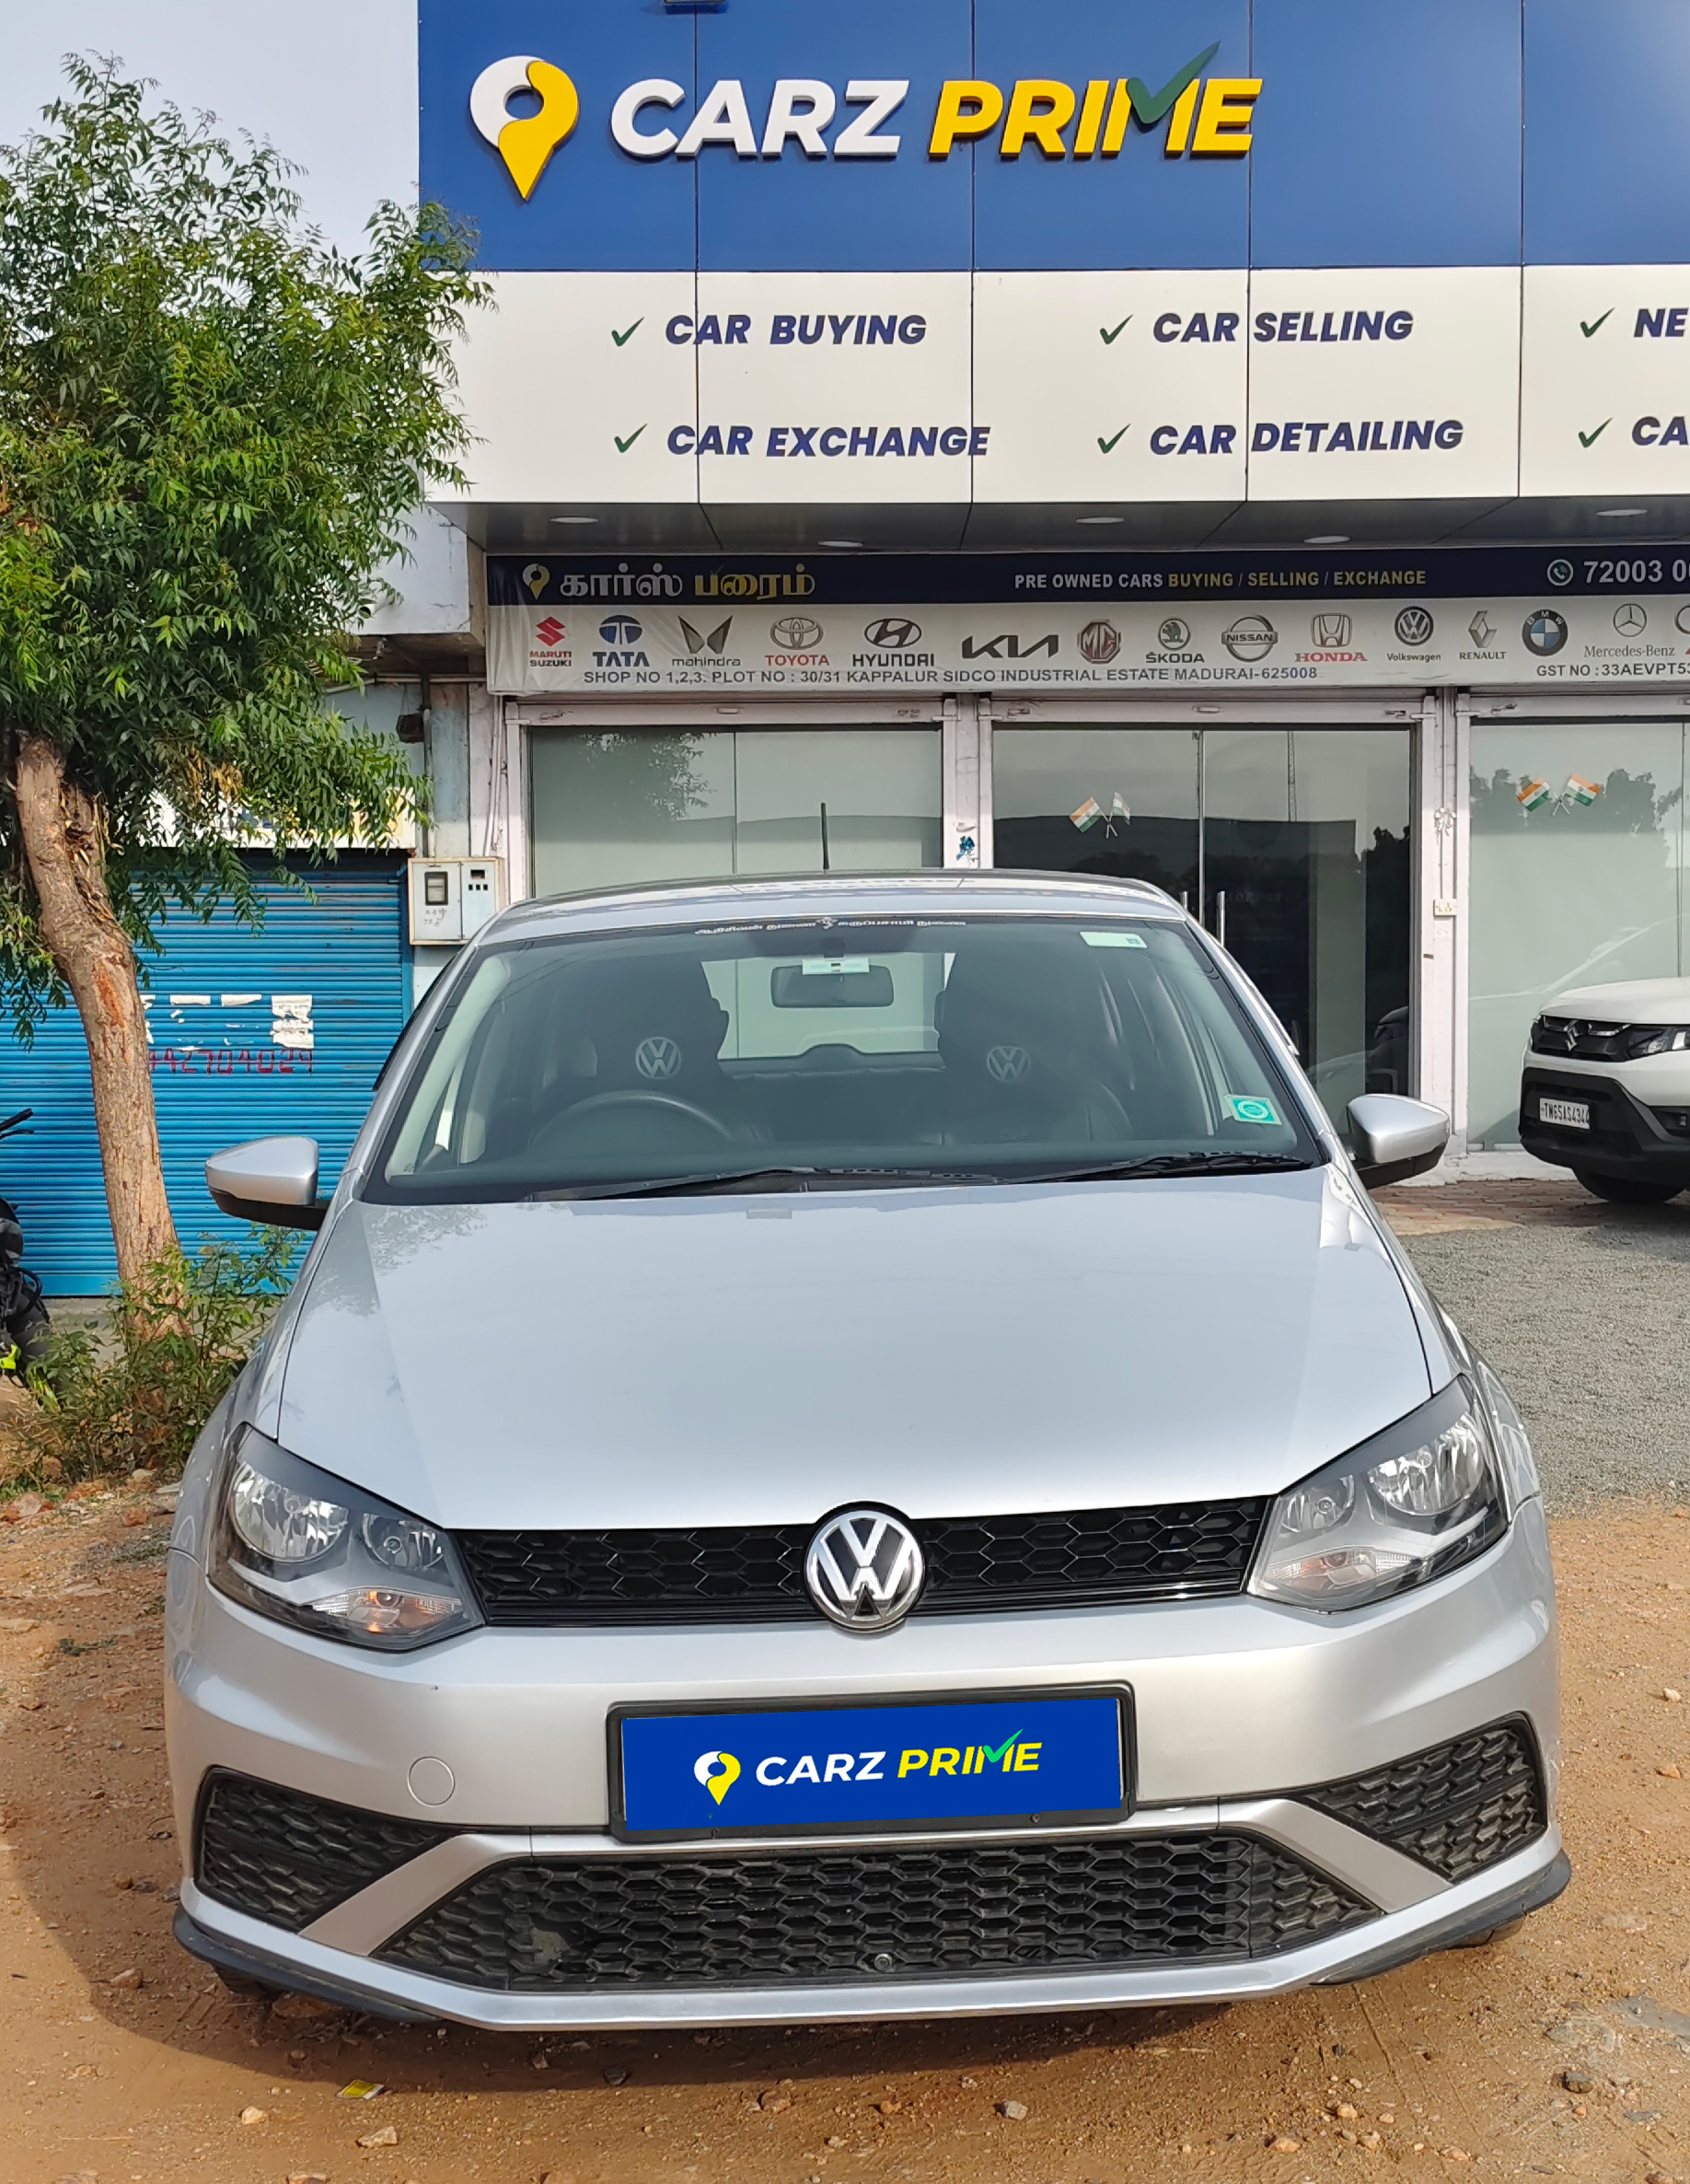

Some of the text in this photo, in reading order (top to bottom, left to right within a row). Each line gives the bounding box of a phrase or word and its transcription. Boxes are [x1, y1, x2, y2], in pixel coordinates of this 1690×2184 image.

[611, 72, 1263, 157] CARZ PRIME
[665, 314, 927, 345] CAR BUYING
[1152, 310, 1414, 343] CAR SELLING
[1634, 308, 1690, 338] NE
[1149, 419, 1464, 456] CAR DETAILING
[1631, 415, 1690, 447] CA
[666, 424, 991, 458] CAR EXCHANGE
[1583, 559, 1690, 584] 72003 0
[1014, 574, 1048, 589] PRE
[1052, 574, 1113, 588] OWNED
[1117, 573, 1163, 588] CARS
[1167, 572, 1233, 587] BUYING
[1247, 571, 1320, 587] SELLING
[1333, 570, 1427, 586] EXCHANGE
[1526, 610, 1565, 625] BMW
[1226, 633, 1274, 643] NISSAN
[529, 650, 573, 658] MARUTI
[1145, 651, 1206, 664] ŠKODA
[1294, 652, 1368, 663] HONDA
[1386, 652, 1441, 663] Volkswagen
[1459, 651, 1507, 660] RENAULT
[1583, 644, 1676, 658] Mercedes-Benz
[529, 659, 573, 668] SUZUKI
[592, 651, 650, 668] TATA
[671, 656, 742, 668] mahindra
[764, 655, 830, 667] TOYOTA
[852, 653, 935, 668] HYUNDAI
[584, 671, 631, 683] SHOP
[636, 671, 661, 683] NO
[712, 671, 757, 683] PLOT
[761, 670, 785, 683] NO
[800, 670, 839, 683] 30/31
[847, 669, 938, 683] KAPPALUR
[943, 669, 996, 682] SIDCO
[1001, 668, 1102, 682] INDUSTRIAL
[1106, 668, 1169, 681] ESTATE
[1175, 667, 1318, 680] MADURAI-625008
[1536, 665, 1567, 677] GST
[1569, 664, 1591, 677] NO
